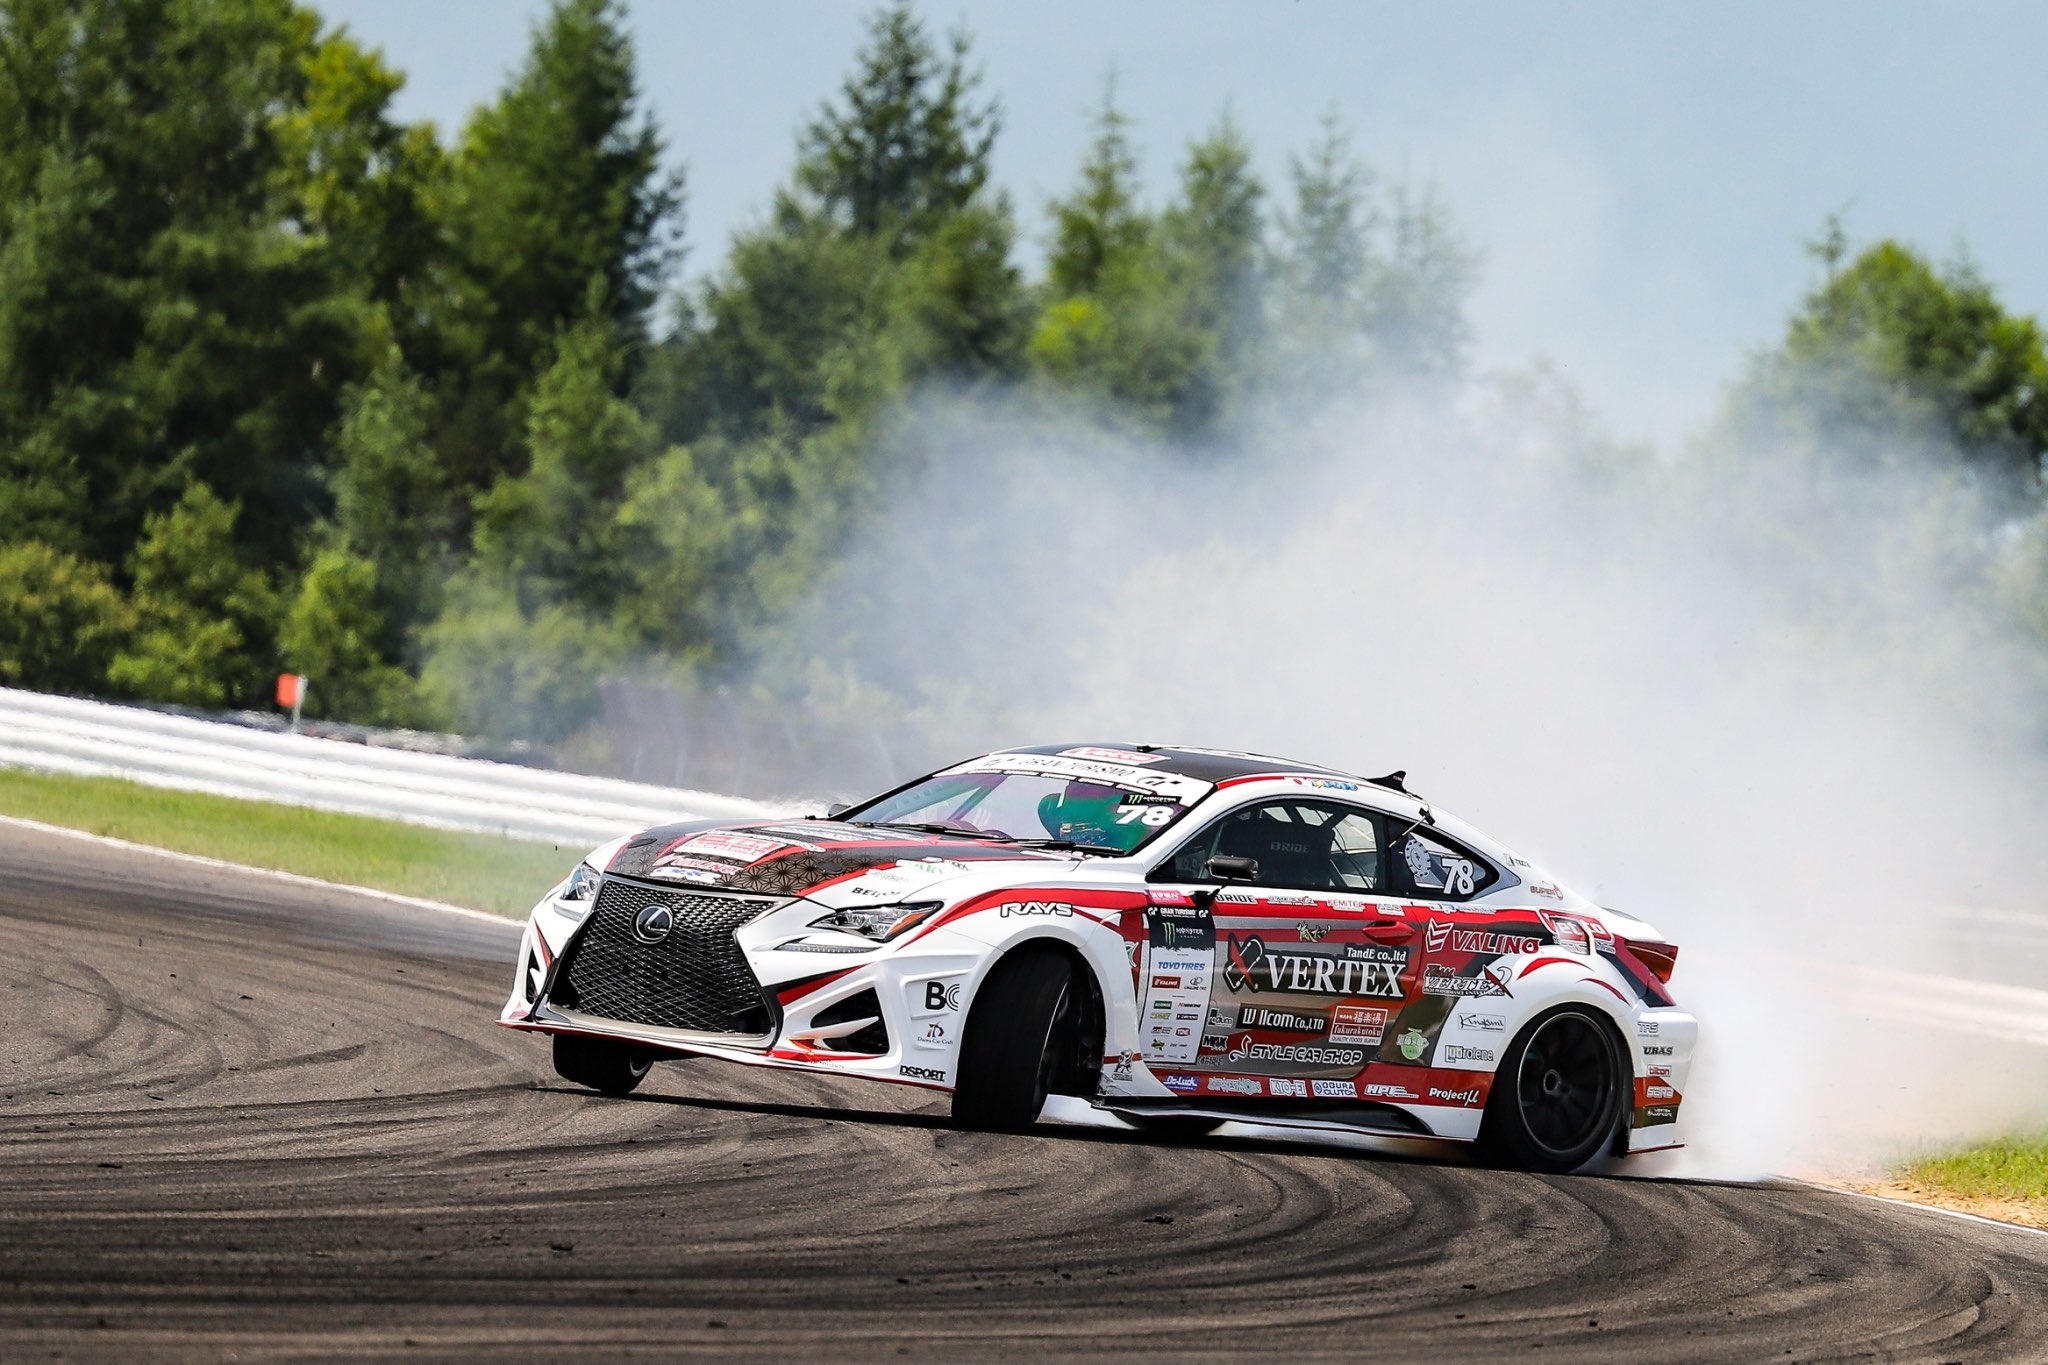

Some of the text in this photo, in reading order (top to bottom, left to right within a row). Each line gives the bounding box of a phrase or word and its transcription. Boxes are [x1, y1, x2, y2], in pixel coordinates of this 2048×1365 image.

[1115, 805, 1174, 826] 78
[1270, 841, 1311, 853] BRIDE
[1441, 857, 1475, 895] 78
[1000, 901, 1074, 918] RAYS
[1175, 927, 1204, 936] MONSTER
[1452, 929, 1542, 954] VALINO
[1346, 947, 1376, 960] TandE
[1264, 954, 1407, 998] VERTEX
[1637, 1021, 1659, 1034] TRS
[1250, 1044, 1296, 1061] STYLE
[1322, 1048, 1363, 1066] SHOP
[1642, 1046, 1674, 1056] URAS
[899, 1065, 946, 1080] DSPORT
[1648, 1065, 1670, 1076] tilton
[1322, 1088, 1357, 1096] CLUTCH
